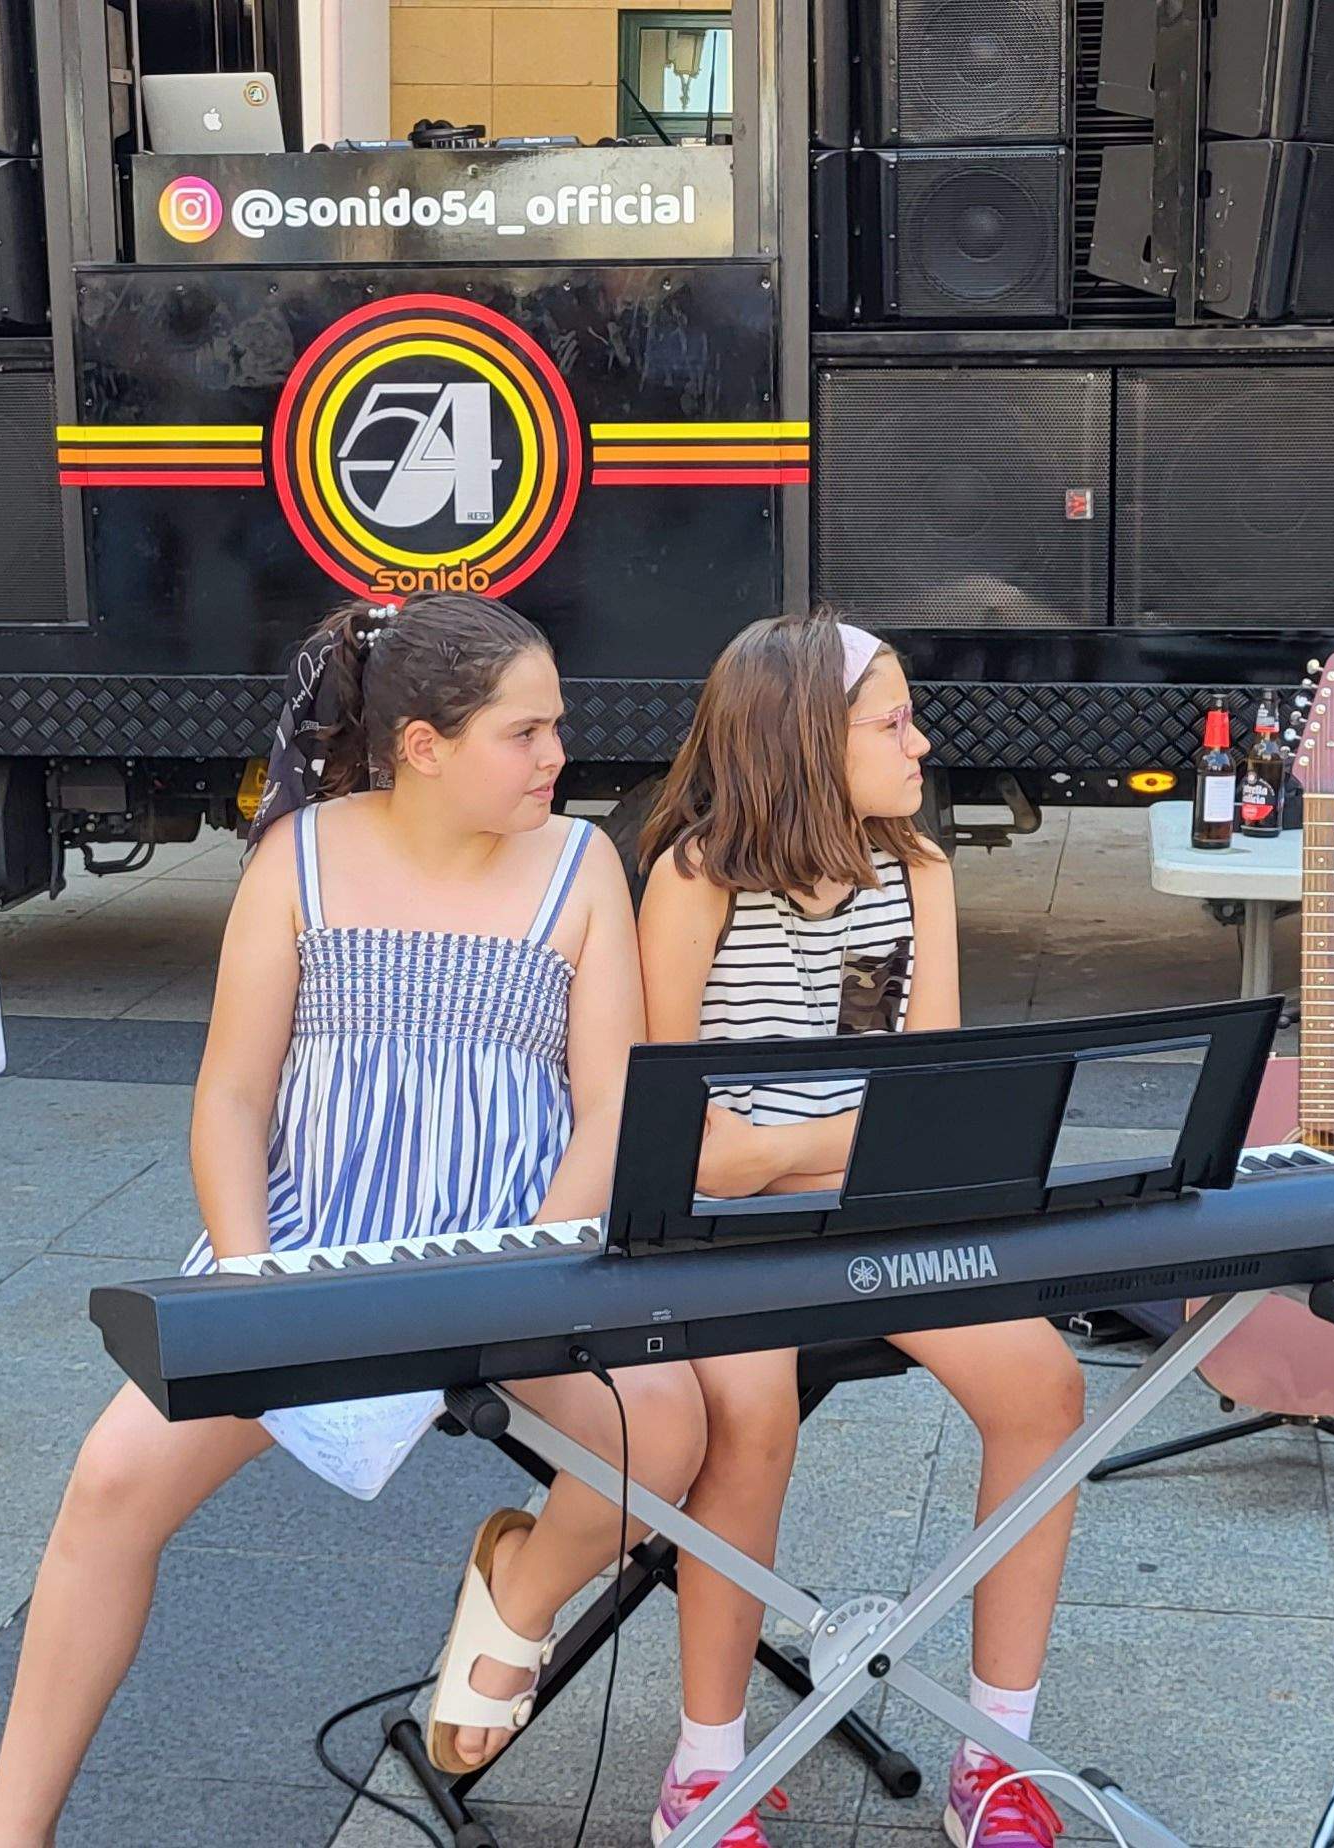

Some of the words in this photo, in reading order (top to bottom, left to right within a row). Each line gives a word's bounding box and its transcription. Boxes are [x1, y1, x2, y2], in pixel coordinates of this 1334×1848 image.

[231, 183, 695, 239] @sonido54_official
[337, 382, 503, 528] 54
[370, 561, 490, 592] sonido
[881, 1245, 998, 1289] YAMAHA
